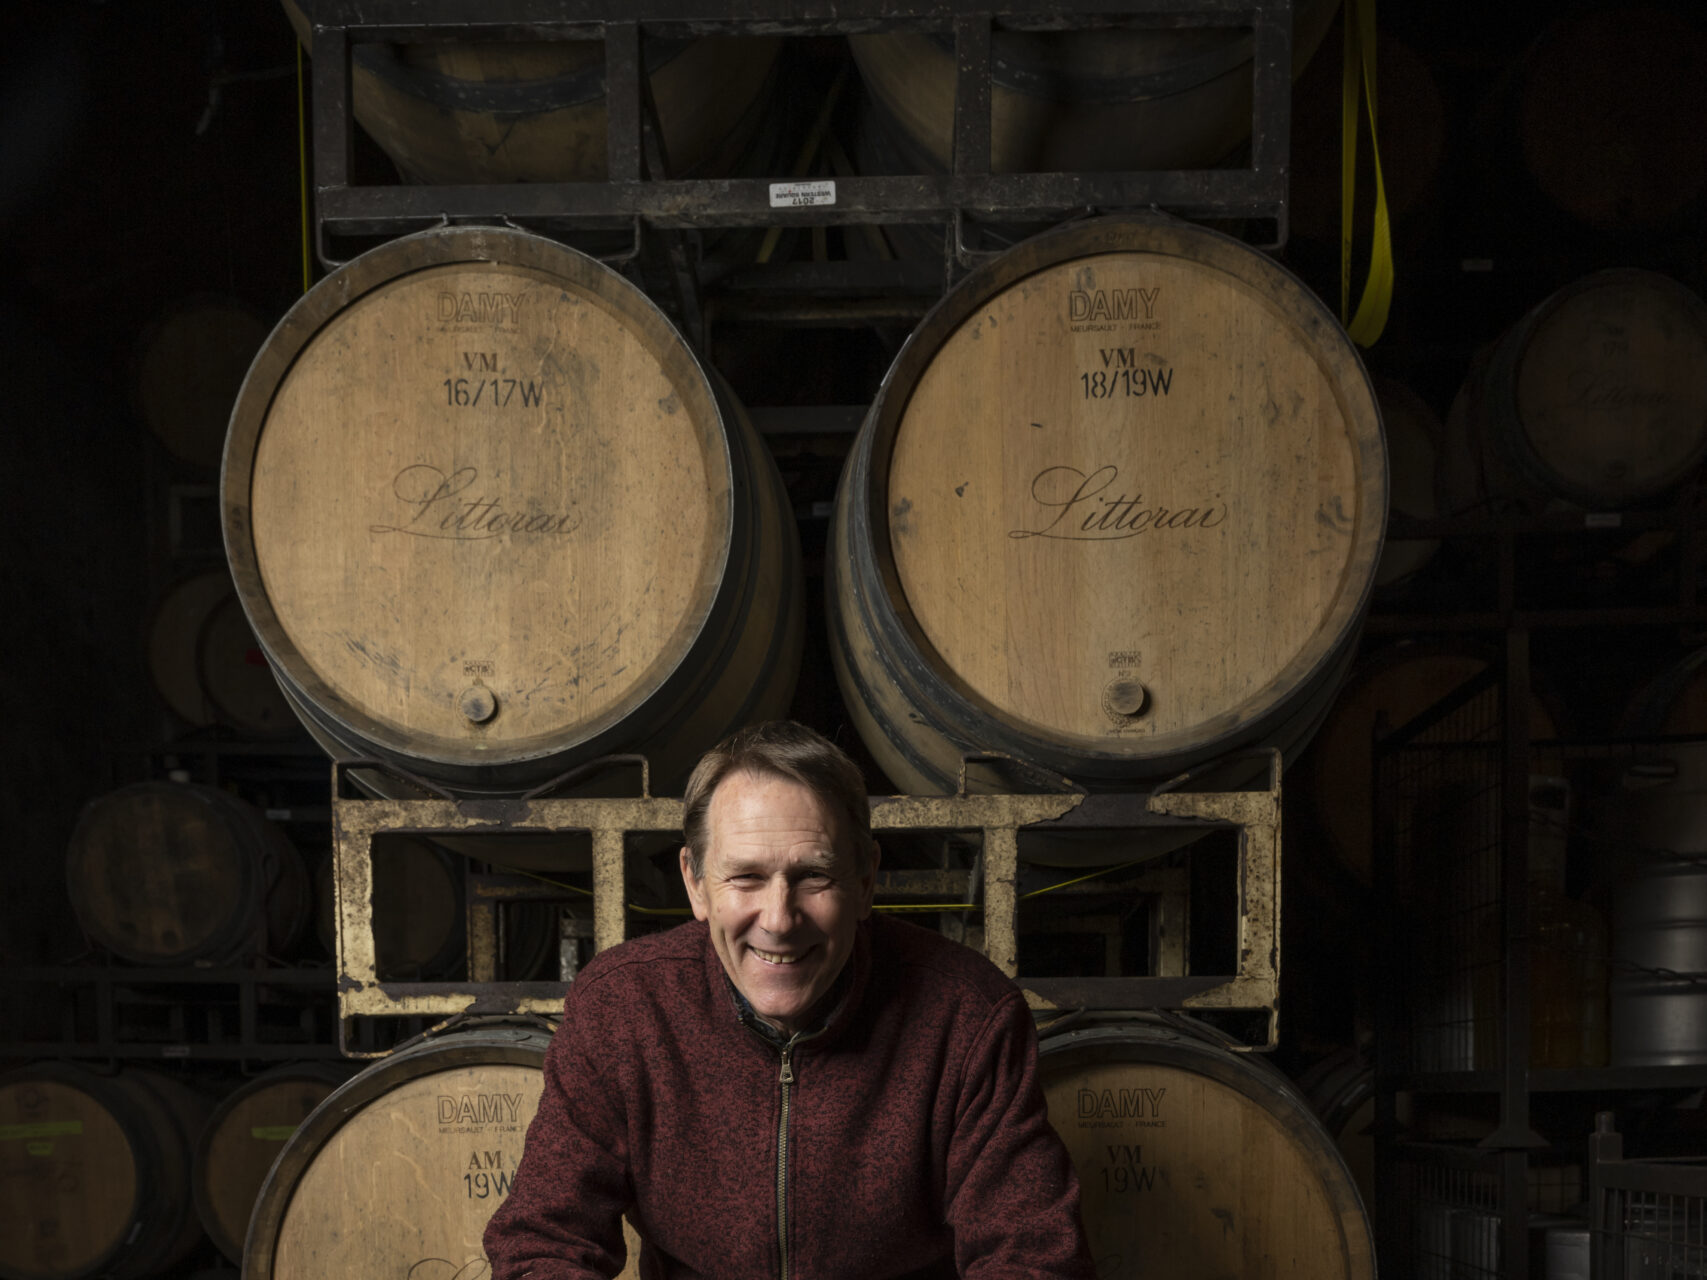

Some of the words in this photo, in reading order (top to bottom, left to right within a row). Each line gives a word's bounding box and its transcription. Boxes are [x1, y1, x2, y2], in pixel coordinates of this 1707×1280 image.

[792, 197, 815, 205] 2017
[437, 291, 526, 324] DAMY
[1070, 287, 1160, 321] DAMY
[463, 352, 499, 373] VM
[1099, 347, 1136, 369] VM
[443, 378, 545, 408] 16/17W
[1081, 367, 1174, 400] 18/19W
[369, 464, 584, 540] Littorai
[1007, 465, 1228, 541] Littorai
[437, 1093, 524, 1124] DAMY
[1078, 1087, 1166, 1119] DAMY
[468, 1150, 502, 1170] AM
[1106, 1144, 1143, 1165] VM
[463, 1170, 516, 1199] 19W
[1100, 1165, 1157, 1193] 19W
